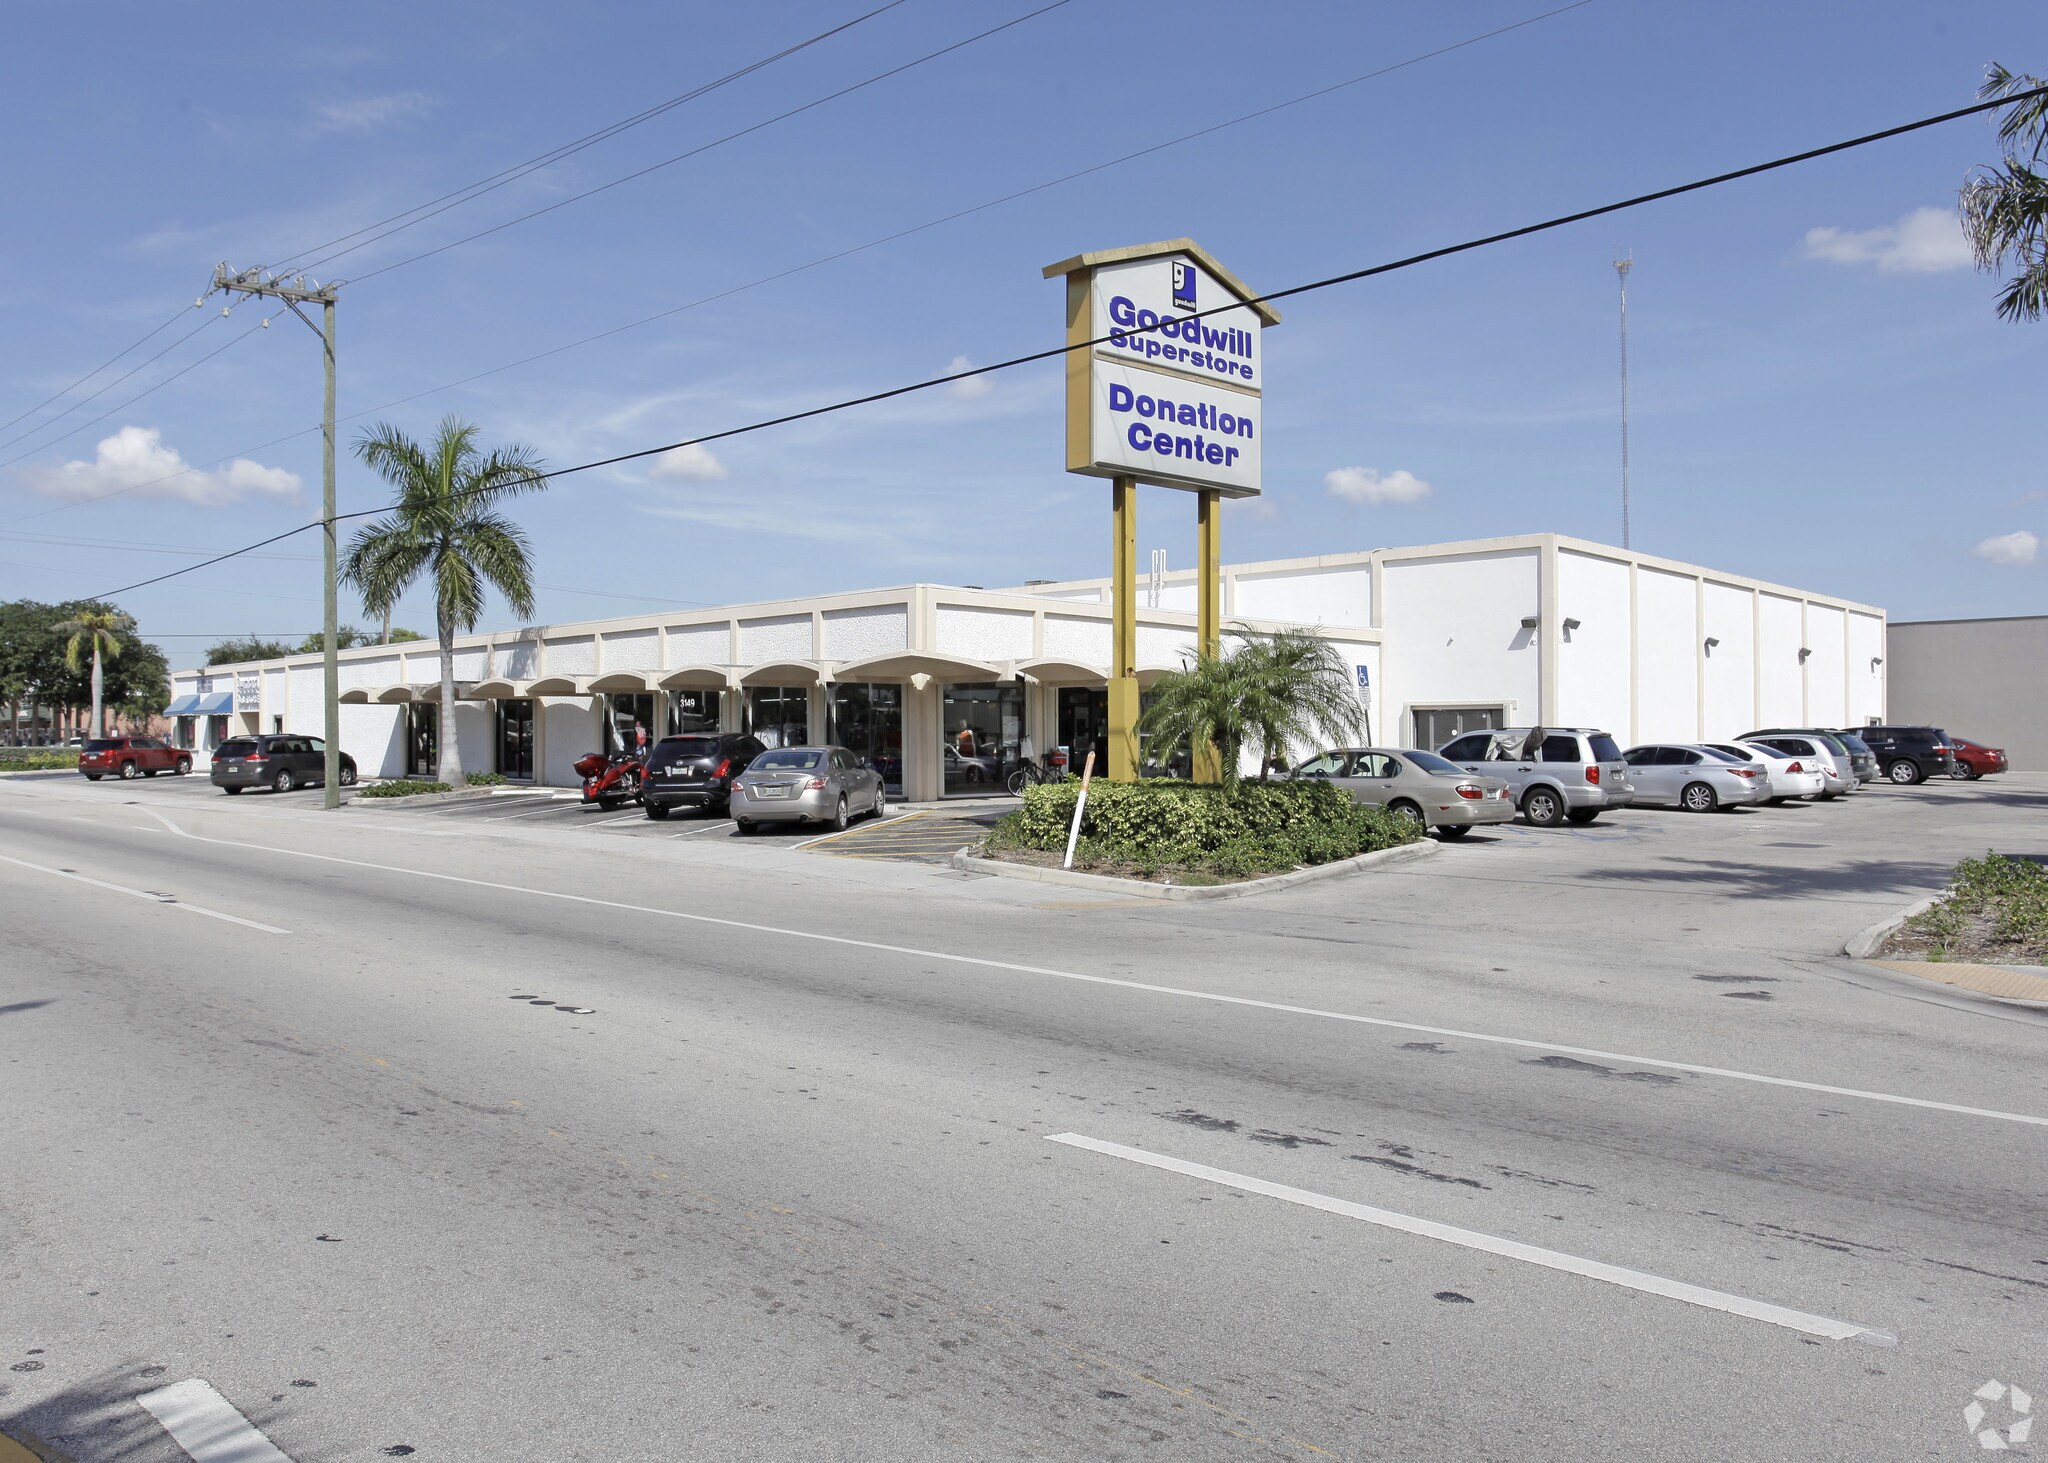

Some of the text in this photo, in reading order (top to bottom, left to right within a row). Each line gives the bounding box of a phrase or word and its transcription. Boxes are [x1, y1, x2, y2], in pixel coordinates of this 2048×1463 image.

[1109, 295, 1252, 358] Goodwill
[1109, 327, 1253, 379] Superstore
[1109, 383, 1253, 438] Donation
[1127, 423, 1239, 466] Center
[680, 698, 695, 708] 3149
